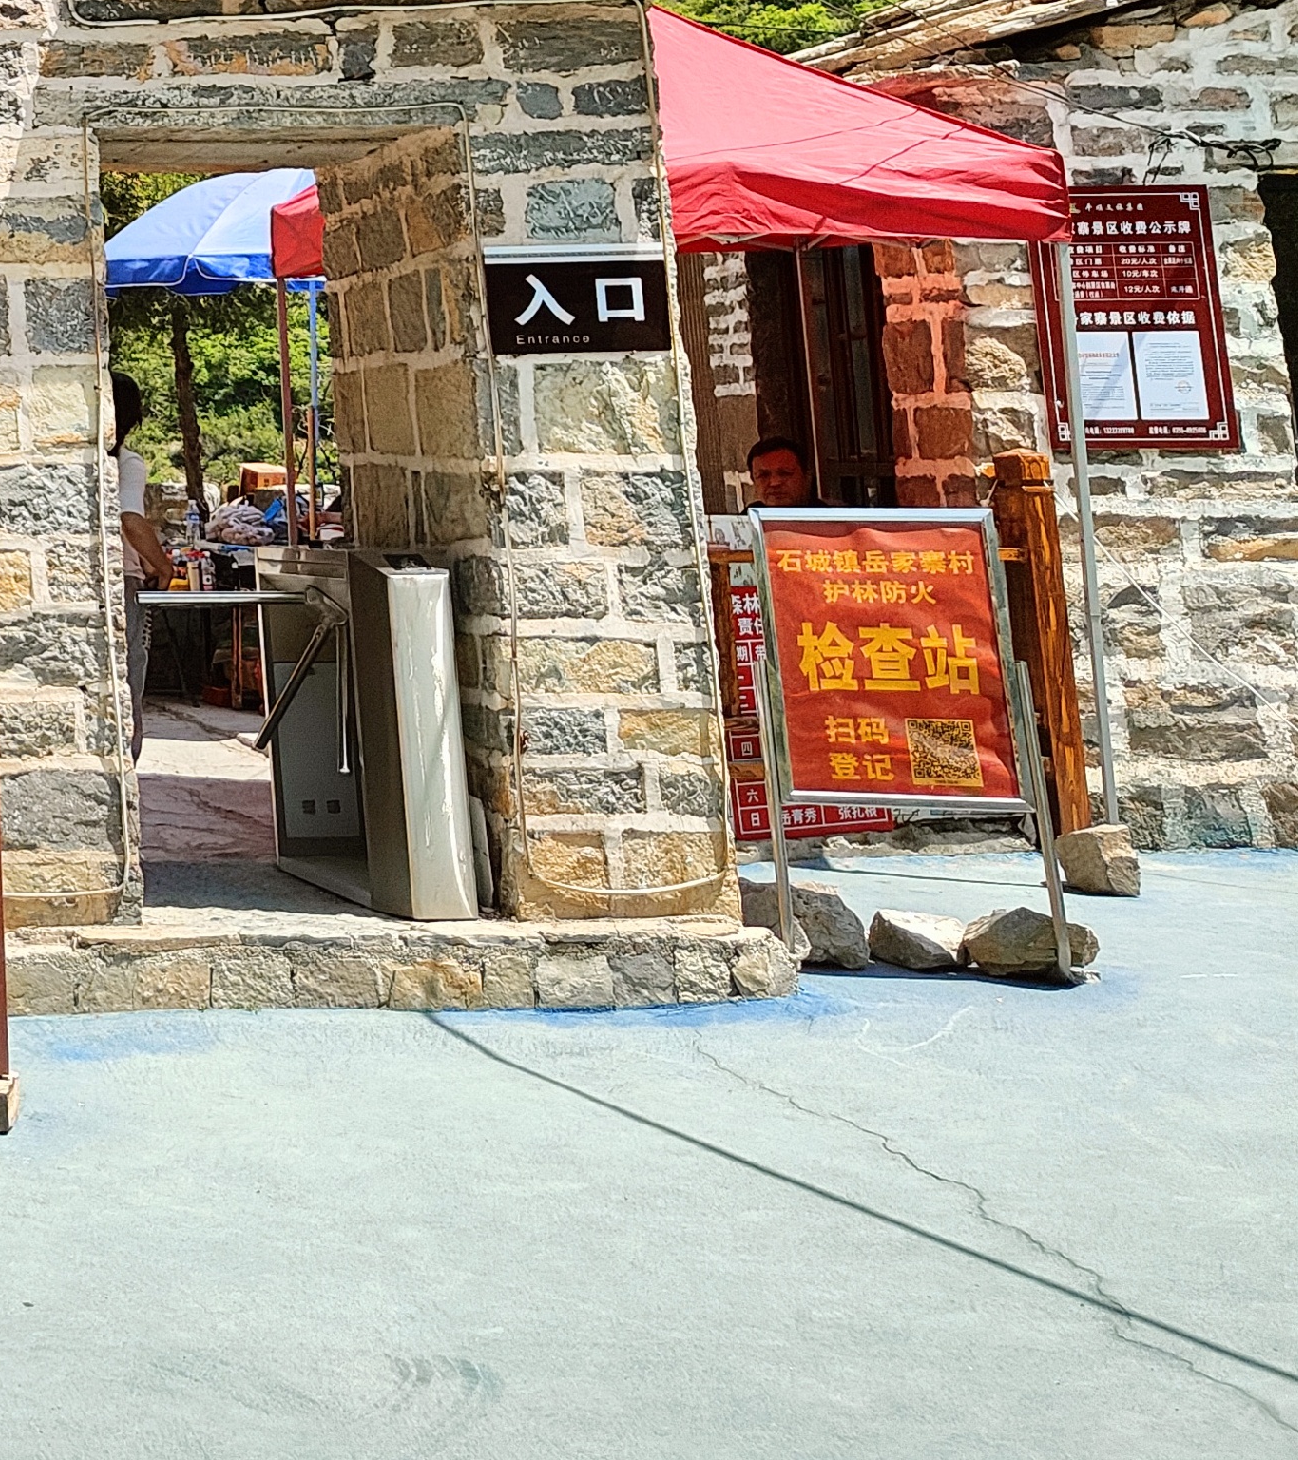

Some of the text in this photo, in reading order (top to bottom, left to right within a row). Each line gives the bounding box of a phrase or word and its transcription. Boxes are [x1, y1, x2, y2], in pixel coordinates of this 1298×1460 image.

[1071, 220, 1191, 235] 寨景区收费公示牌
[1071, 258, 1103, 266] 区门票
[514, 273, 646, 326] 入口
[1074, 311, 1196, 326] 家寨景区收费依据
[516, 333, 591, 345] Entrance
[776, 548, 974, 576] 石城镇岳家寨村
[822, 580, 937, 606] 护林防火
[796, 620, 980, 696] 检查站
[825, 715, 890, 745] 扫码
[829, 752, 895, 781] 登记
